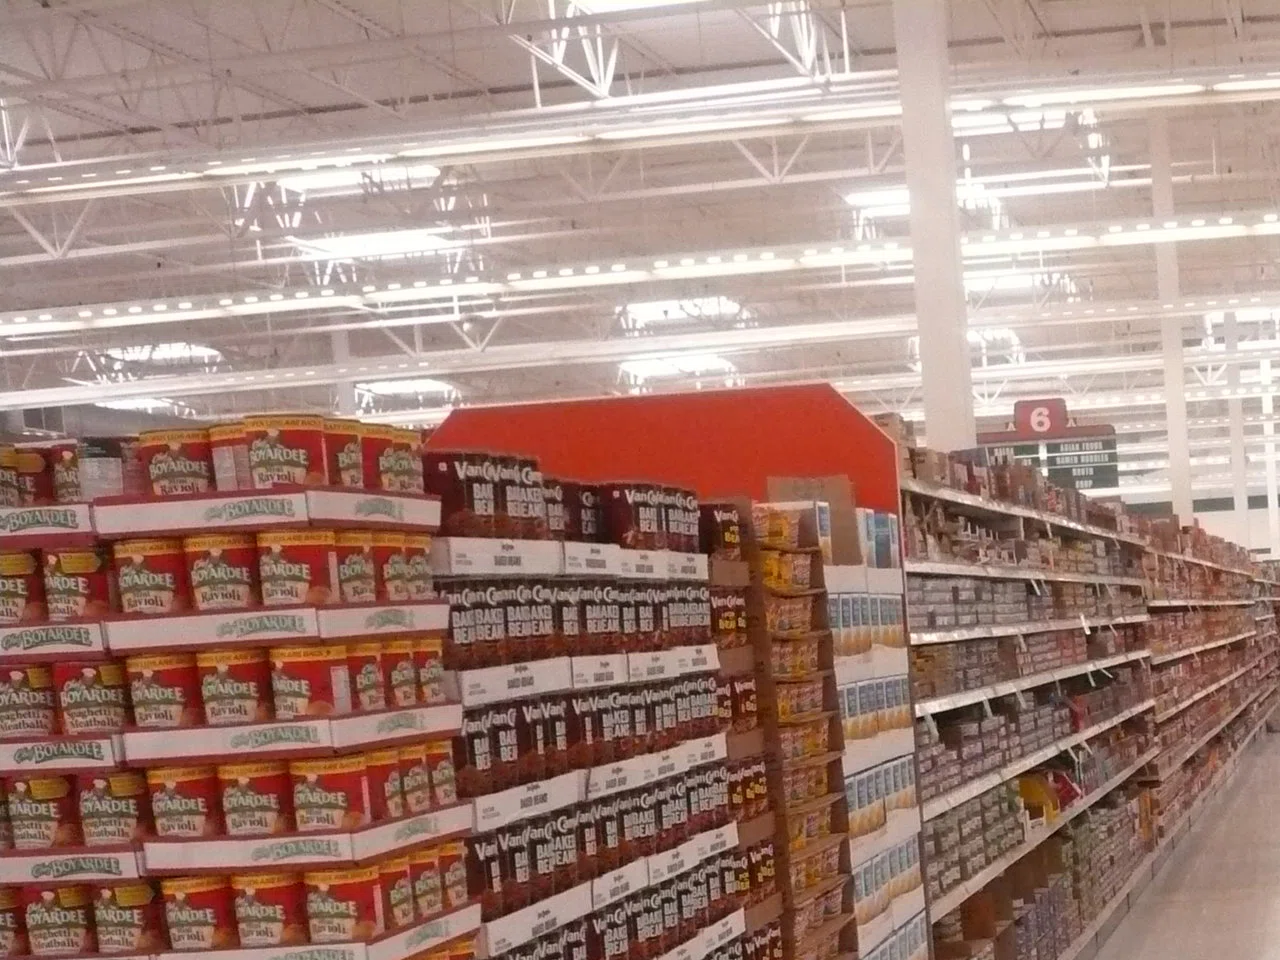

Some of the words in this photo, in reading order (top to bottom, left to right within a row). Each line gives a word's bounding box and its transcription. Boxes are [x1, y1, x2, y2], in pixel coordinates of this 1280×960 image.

[1030, 407, 1050, 432] 6
[9, 509, 79, 532] BOYARDEE
[22, 627, 92, 650] BOYARDEE
[35, 741, 104, 764] BOYARDEE
[52, 857, 122, 878] BOYARDEE
